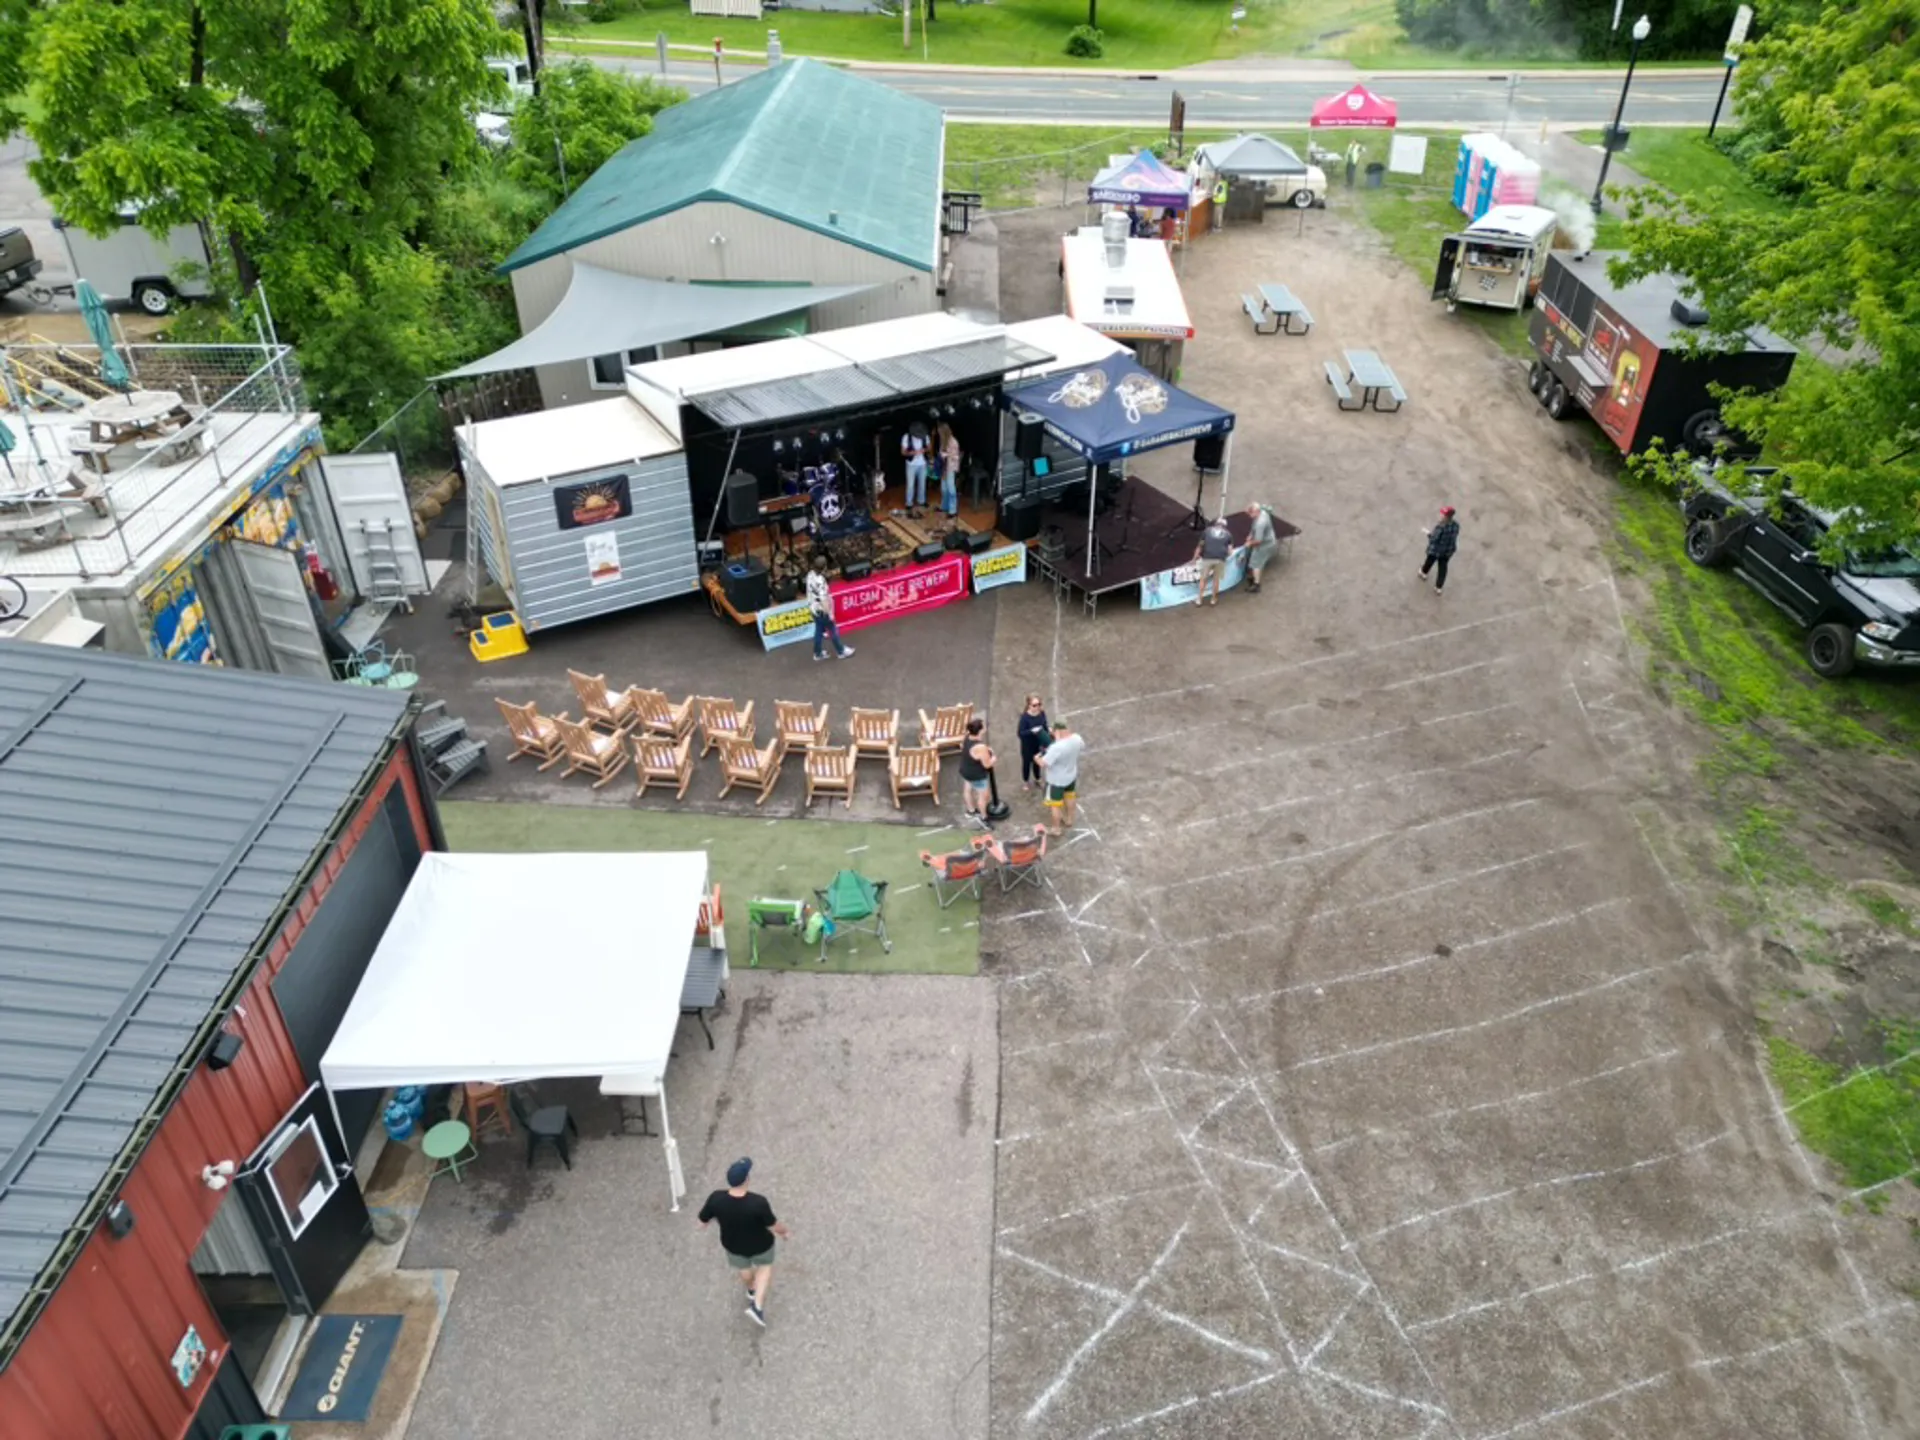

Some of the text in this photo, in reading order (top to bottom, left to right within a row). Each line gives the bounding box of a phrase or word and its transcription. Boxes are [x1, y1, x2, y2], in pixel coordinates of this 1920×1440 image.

[843, 590, 879, 610] BALSAM
[909, 570, 949, 590] BREWERY
[328, 1320, 364, 1394] GIANT
